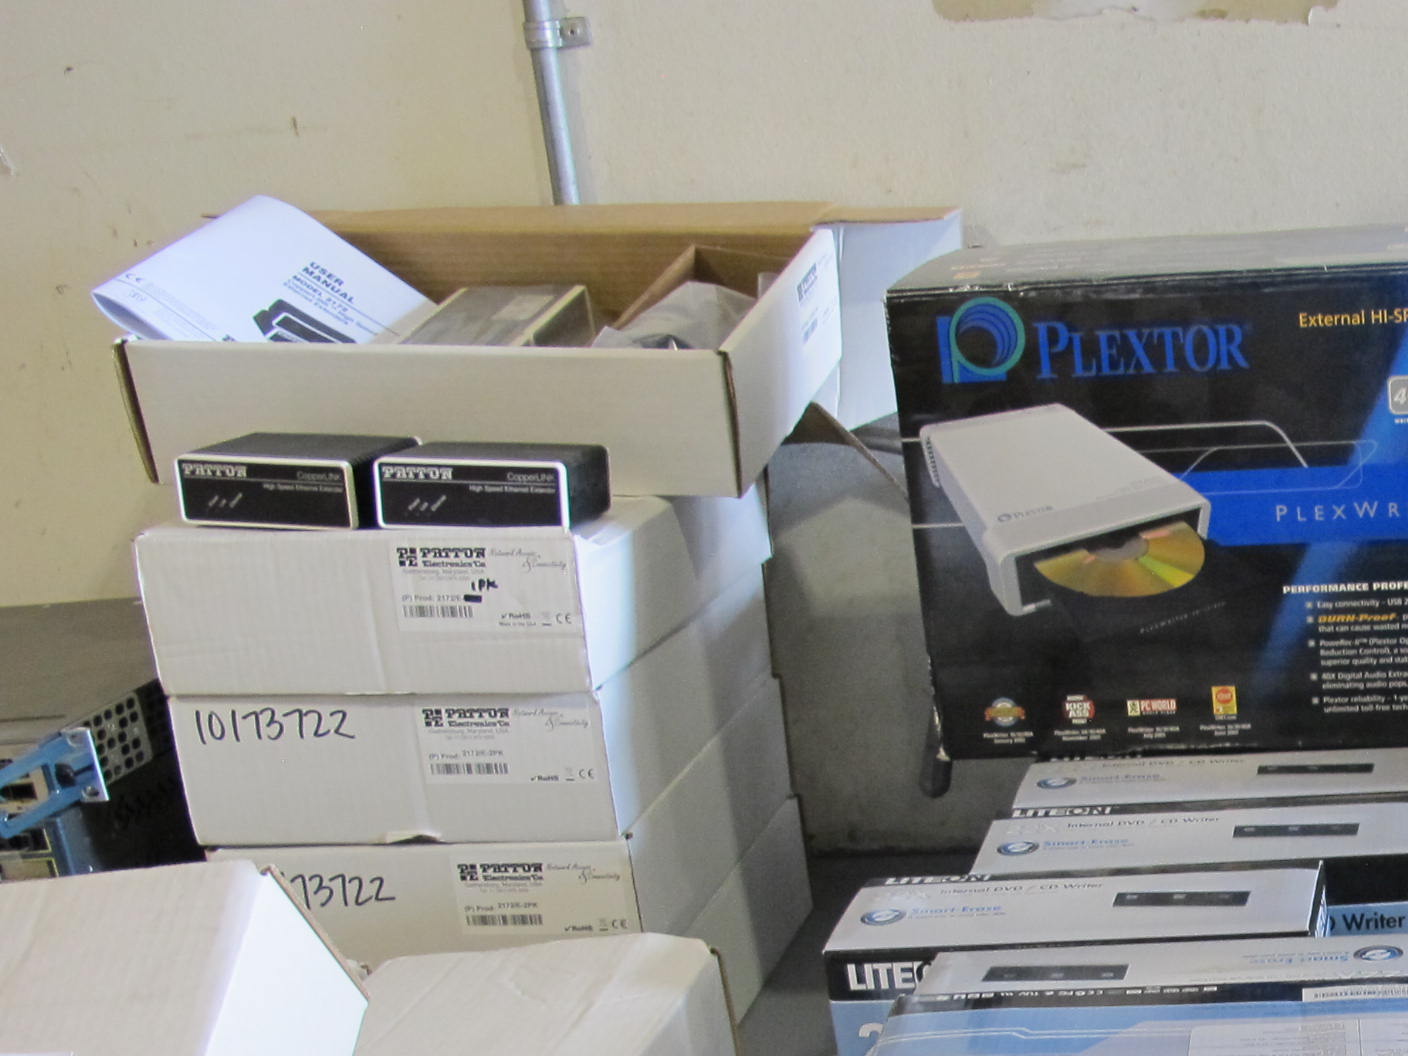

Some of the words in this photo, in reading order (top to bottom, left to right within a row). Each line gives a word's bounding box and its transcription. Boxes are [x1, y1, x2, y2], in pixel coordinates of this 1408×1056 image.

[310, 261, 344, 287] USER
[302, 267, 356, 302] MANUAL
[1299, 311, 1365, 327] External
[1033, 321, 1250, 380] PLEXTOR
[182, 463, 247, 477] PATTON
[382, 467, 452, 480] PATTON
[420, 548, 486, 558] PATTON
[1283, 583, 1368, 594] PERFORMANCE
[1335, 599, 1379, 608] connectivity
[1388, 598, 1402, 606] USB
[1379, 656, 1392, 664] and
[1338, 672, 1362, 681] Digital
[1364, 671, 1386, 679] Audio
[1141, 701, 1153, 711] PC
[1155, 700, 1176, 710] WORLD
[445, 708, 510, 718] PATTON
[195, 708, 355, 745] 10173722
[480, 864, 543, 872] PATTON
[281, 873, 395, 909] 73722
[1342, 912, 1405, 930] Writer
